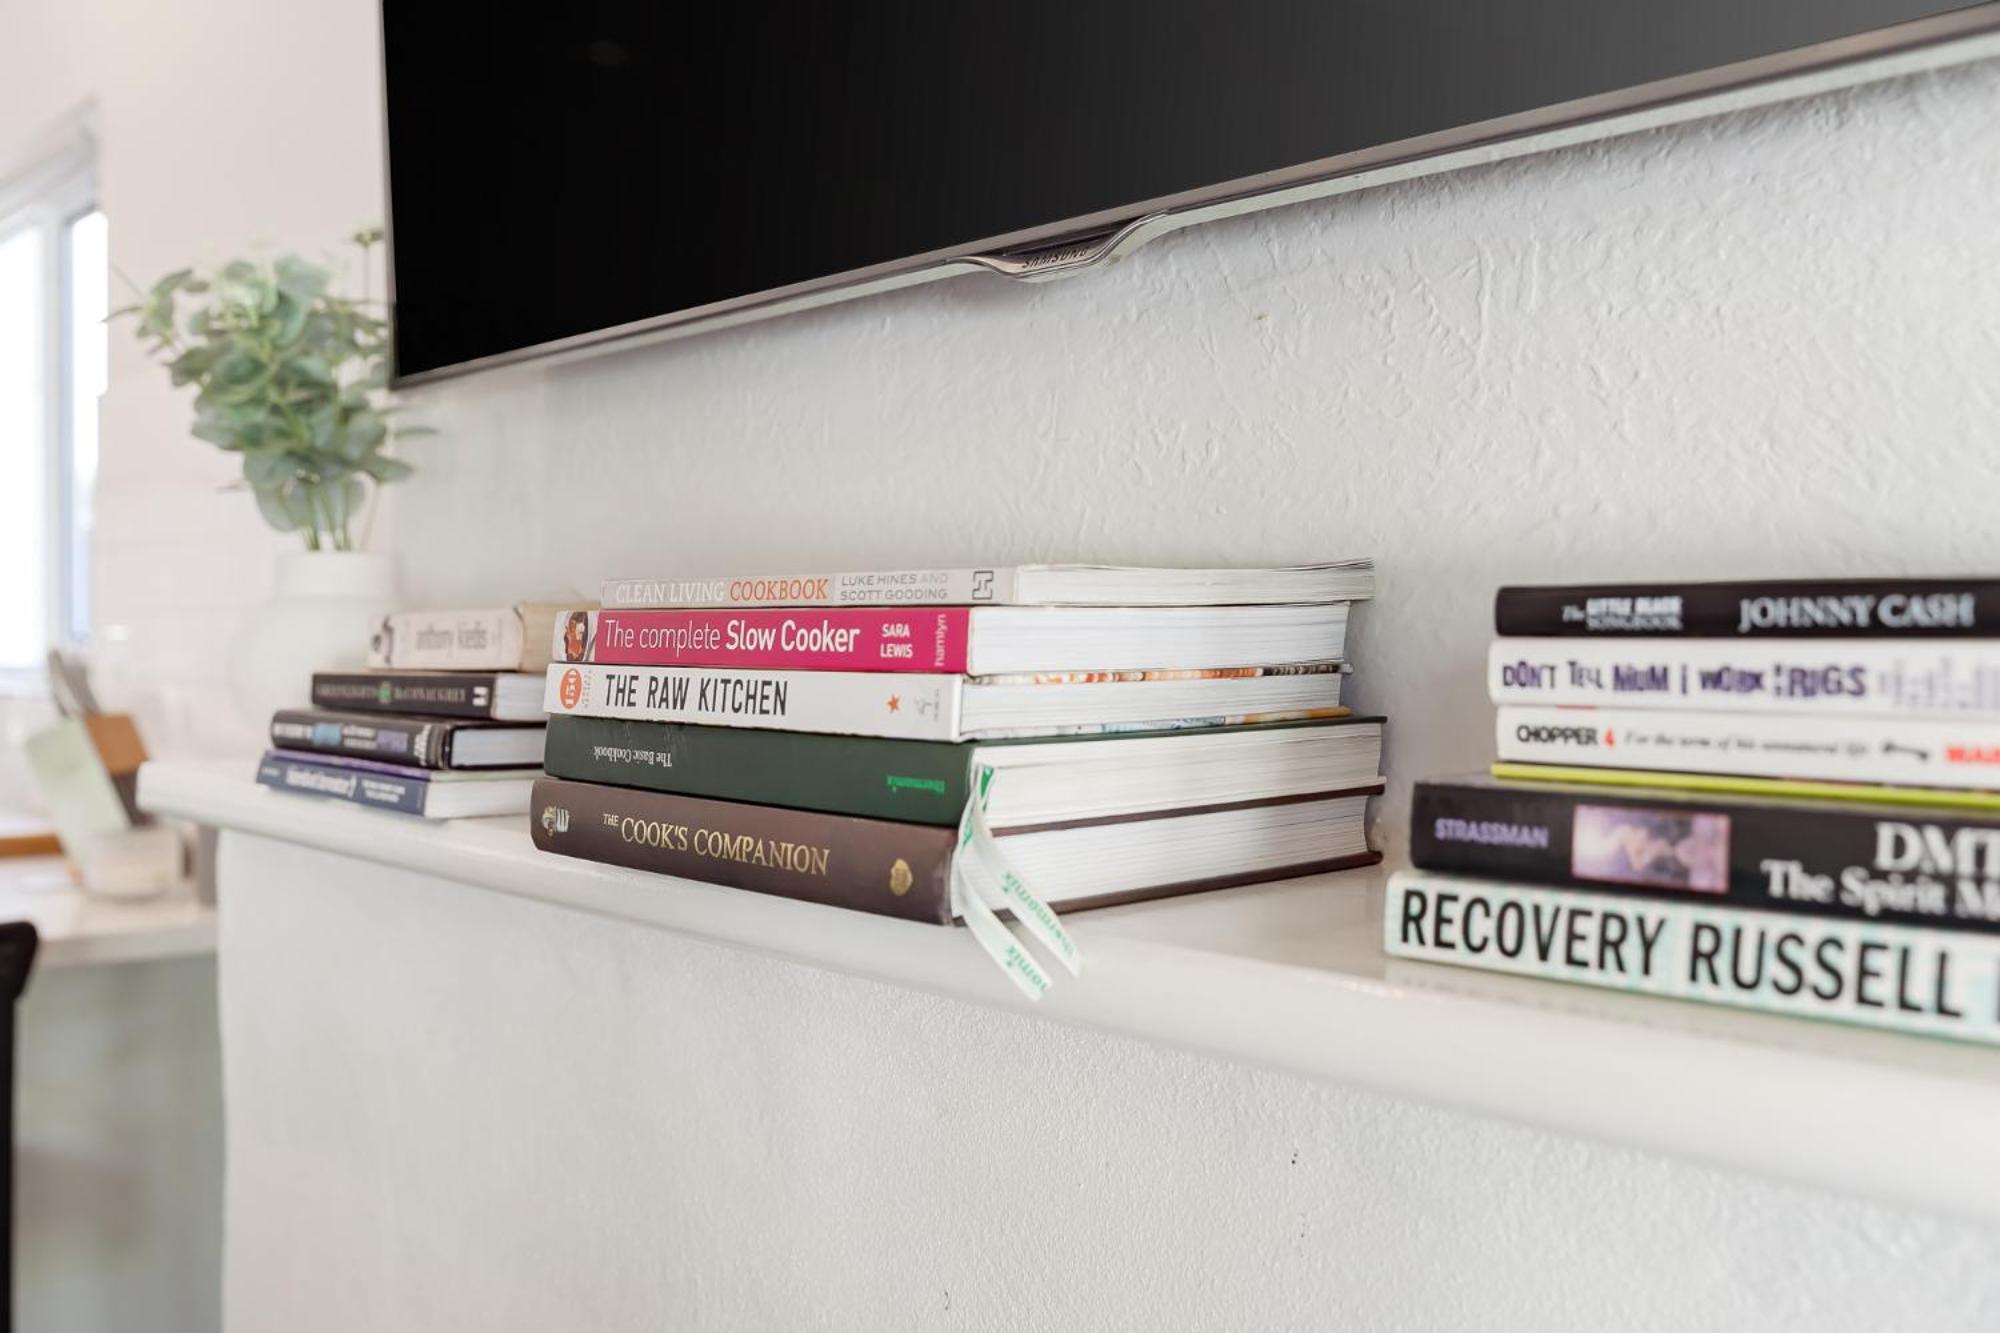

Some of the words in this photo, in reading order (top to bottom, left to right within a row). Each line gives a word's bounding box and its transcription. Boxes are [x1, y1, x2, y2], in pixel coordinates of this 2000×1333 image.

[1021, 247, 1090, 269] SAMSUNG
[616, 583, 667, 604] CLEAN
[669, 581, 725, 603] LIVING
[729, 579, 828, 601] COOKBOOK
[841, 576, 875, 586] LUKE
[876, 574, 918, 586] HINES
[918, 573, 949, 584] AND
[840, 590, 884, 601] SCOTT
[885, 588, 948, 601] GOODING
[1737, 594, 1875, 634] JOHNNY
[1877, 591, 1976, 629] CASH
[604, 619, 634, 649] The
[639, 619, 721, 658] complete
[725, 619, 776, 651] Slow
[781, 619, 861, 653] Cooker
[881, 623, 911, 638] SARA
[933, 613, 947, 668] hamlyn
[879, 644, 913, 659] LEWIS
[1789, 664, 1867, 698] RIGS
[605, 673, 640, 708] THE
[646, 675, 690, 711] RAW
[697, 677, 788, 716] KITCHEN
[1516, 724, 1598, 746] CHOPPER
[593, 745, 632, 764] Cookbook
[632, 749, 655, 765] Basic
[656, 752, 673, 768] The
[603, 813, 619, 827] THE
[621, 816, 689, 852] COOK'S
[694, 829, 831, 877] COMPANION
[1434, 817, 1549, 848] STRASSMAN
[1760, 858, 1835, 904] The
[1839, 866, 1947, 917] Spirit
[1401, 889, 1666, 976] RECOVERY
[1689, 921, 1963, 1019] RUSSELL
